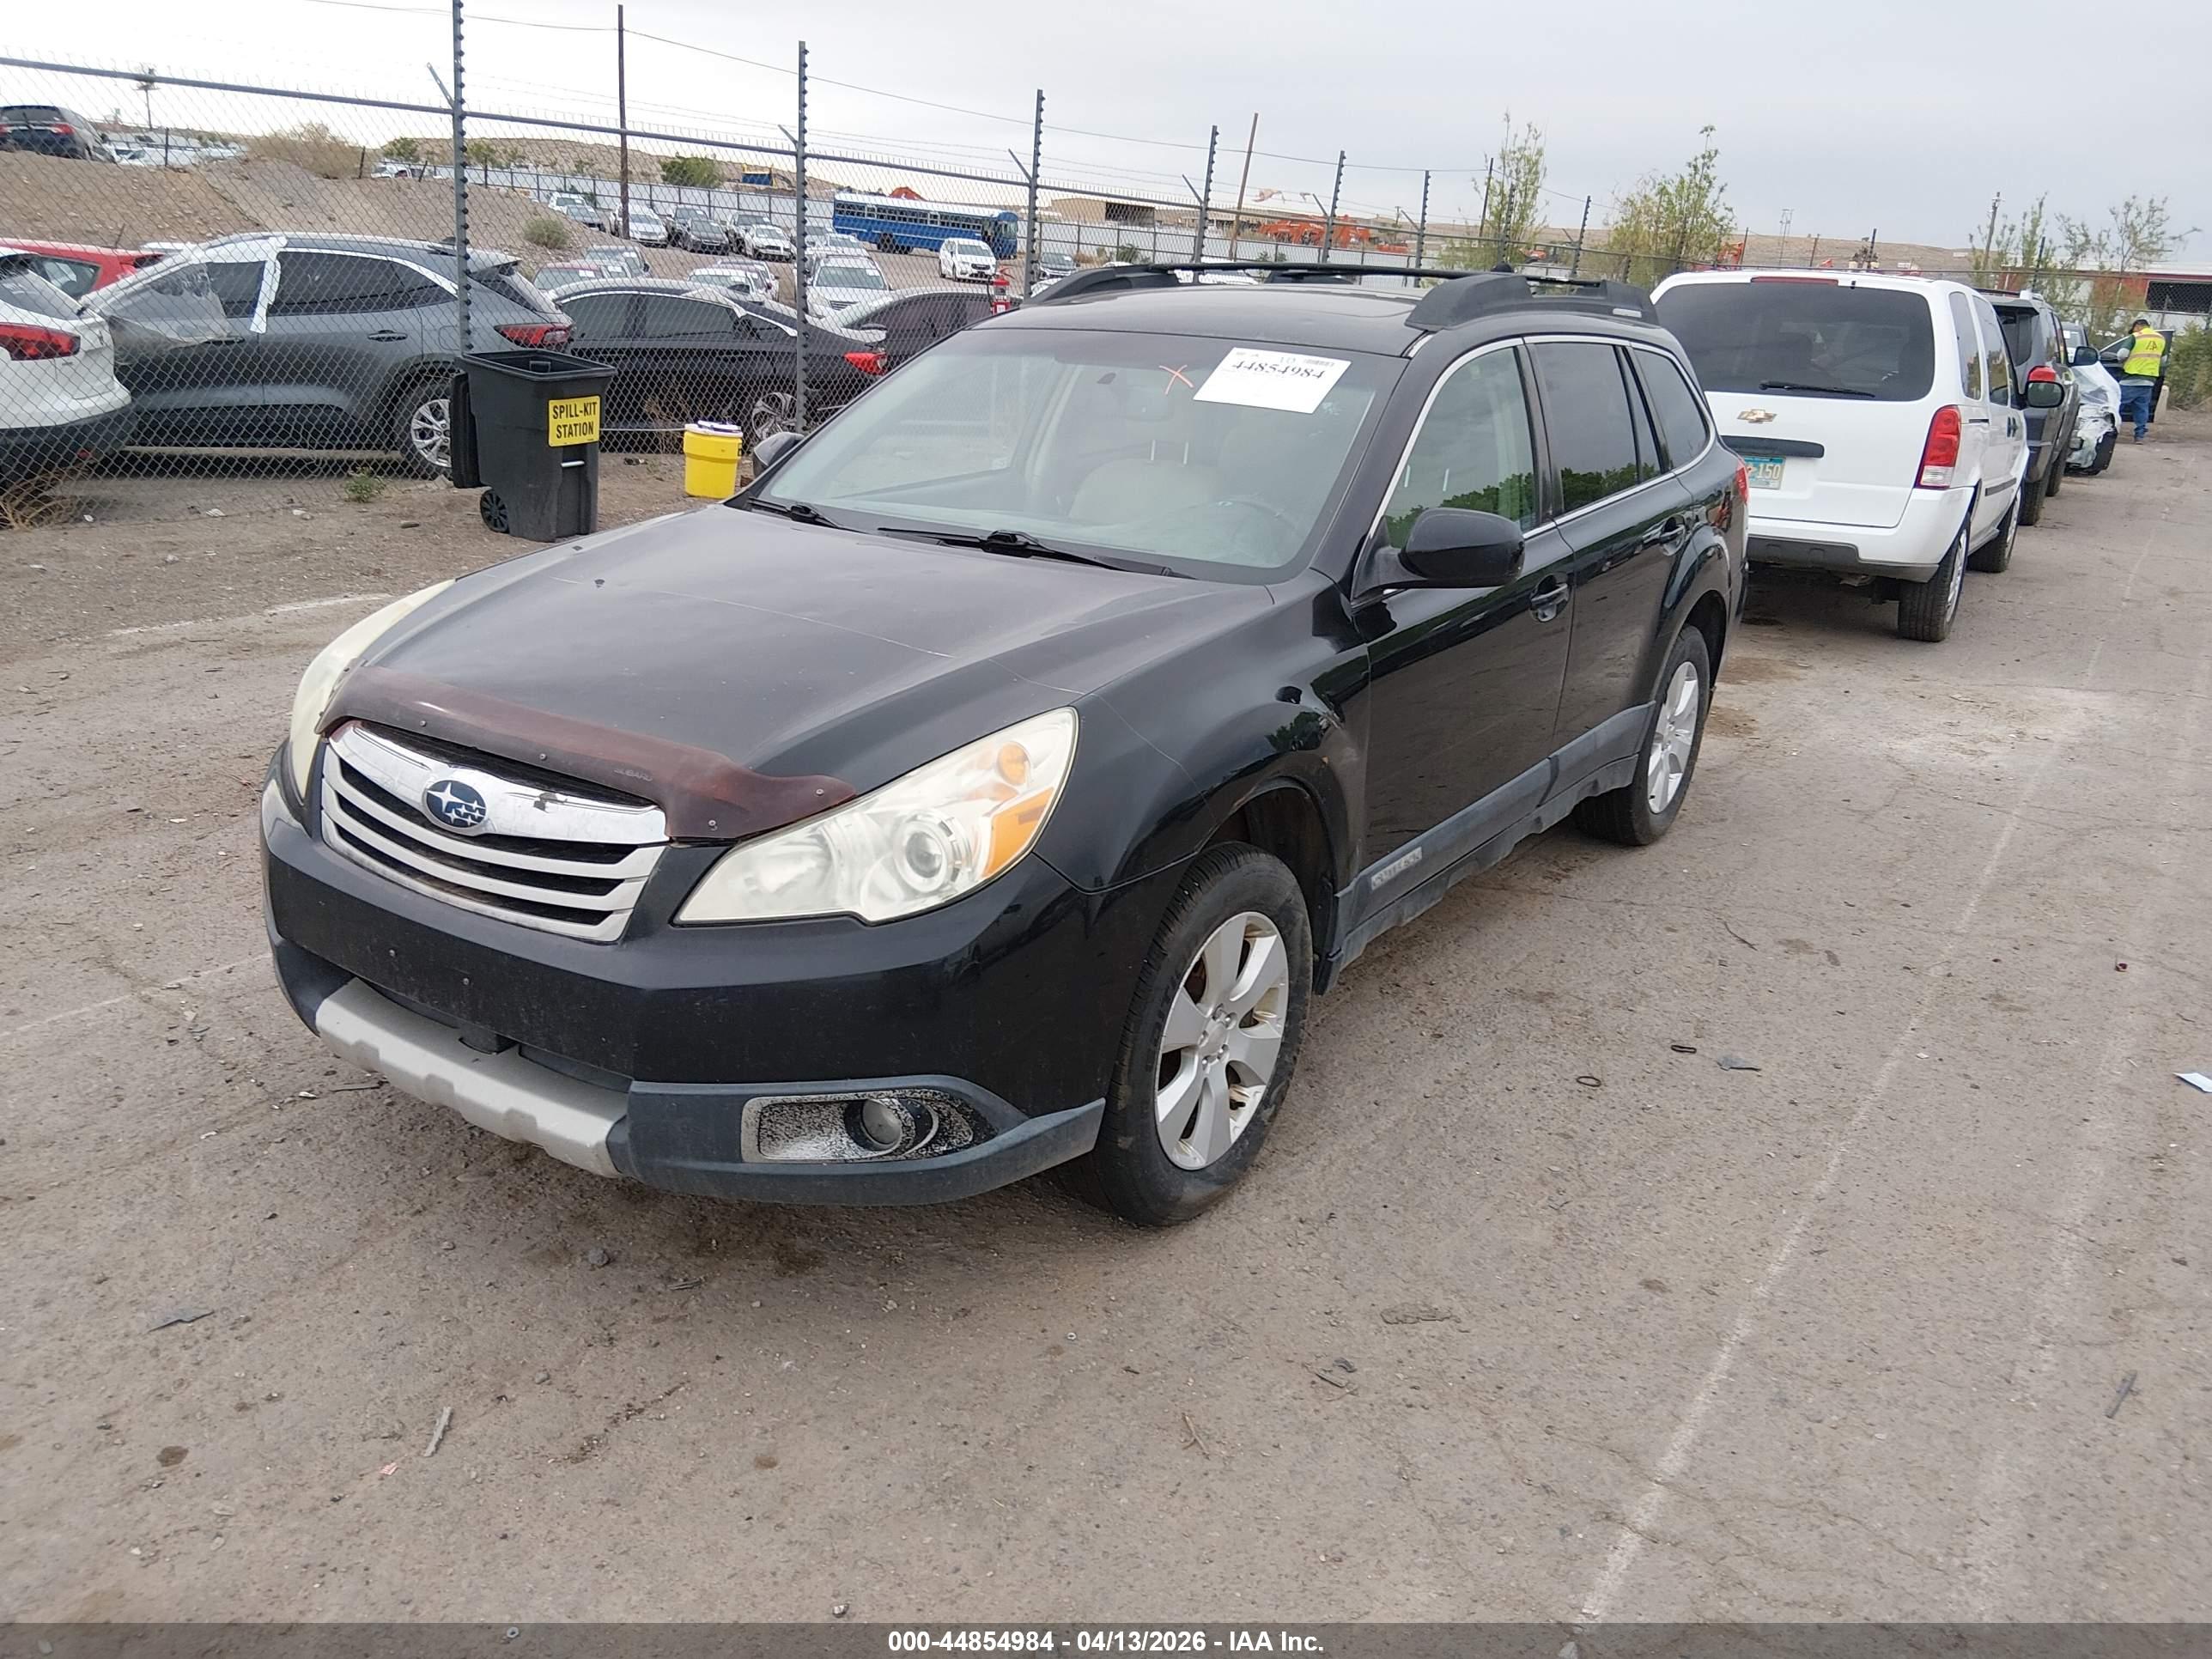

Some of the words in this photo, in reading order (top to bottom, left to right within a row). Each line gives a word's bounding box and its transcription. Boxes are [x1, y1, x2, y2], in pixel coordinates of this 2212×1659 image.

[1231, 360, 1326, 379] 44854984
[552, 402, 598, 419] SPILL-KIT
[556, 422, 594, 439] STATION
[1756, 464, 1782, 480] 150
